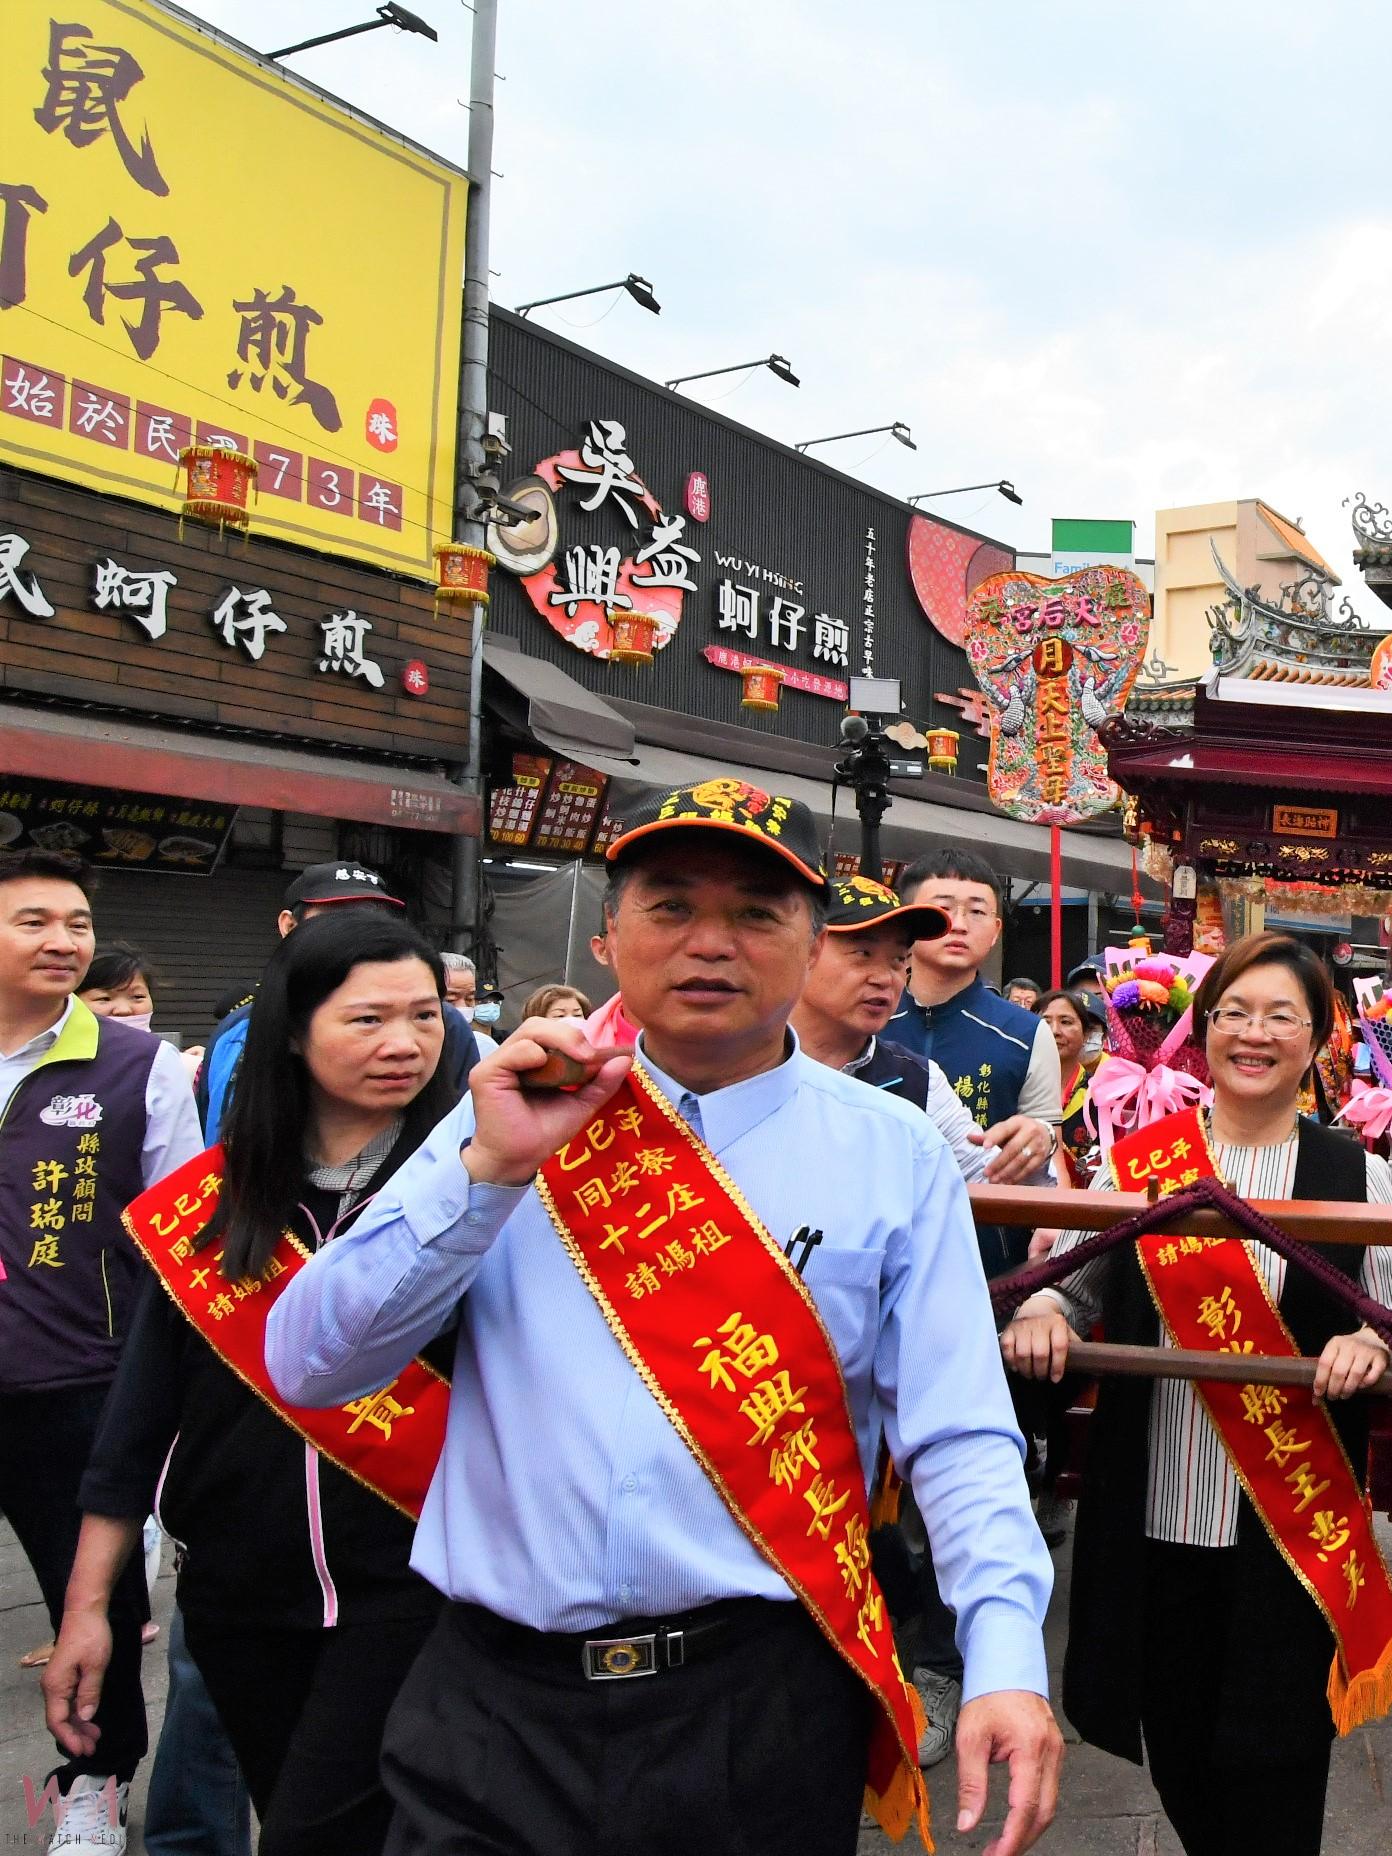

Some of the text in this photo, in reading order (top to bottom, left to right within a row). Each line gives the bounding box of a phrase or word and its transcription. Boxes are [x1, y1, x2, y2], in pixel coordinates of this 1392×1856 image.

[691, 475, 708, 517] 鹿港
[715, 551, 742, 571] WU
[745, 562, 760, 578] YI
[718, 578, 850, 667] 蚵仔煎
[1042, 638, 1064, 673] 月
[50, 1094, 97, 1121] 彰化
[953, 1075, 975, 1098] 楊
[554, 1105, 644, 1172] 乙巳年
[1128, 1137, 1192, 1180] 乙巳年
[71, 1133, 100, 1224] 縣政顧問
[149, 1172, 224, 1237] 乙巳年
[572, 1146, 677, 1217] 同安寮
[28, 1160, 70, 1269] 許瑞庭
[598, 1182, 706, 1256] 十二庄
[623, 1218, 732, 1300] 請媽祖
